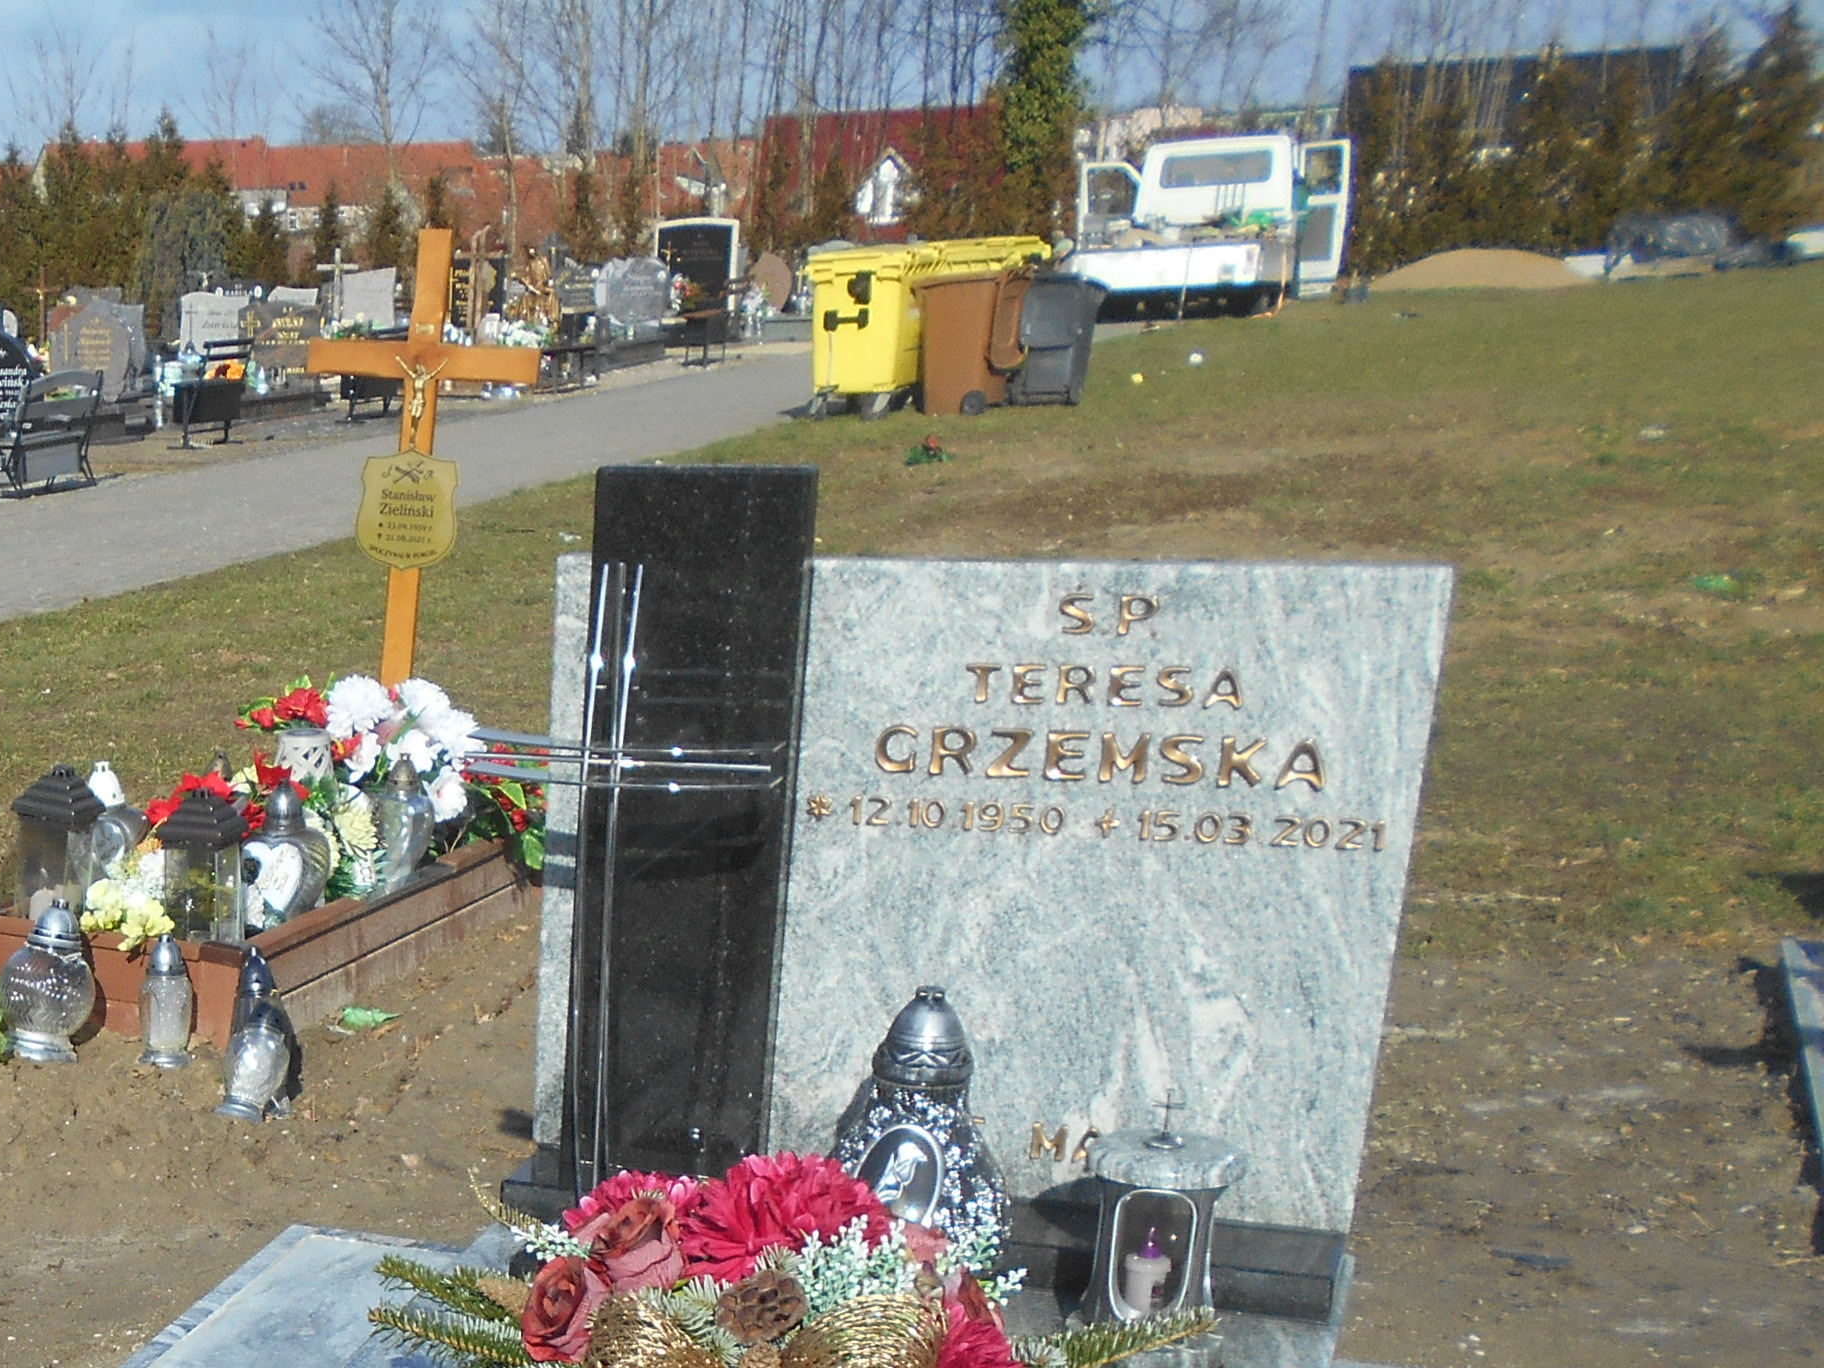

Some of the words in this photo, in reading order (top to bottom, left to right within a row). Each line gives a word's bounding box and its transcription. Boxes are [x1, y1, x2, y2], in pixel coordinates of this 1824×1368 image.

[381, 488, 437, 503] Stanisław
[966, 663, 1243, 709] TERESA
[874, 725, 1327, 792] GRZEMSKA
[848, 794, 1067, 835] 12.10.1950
[1136, 808, 1387, 852] 15.03.2021
